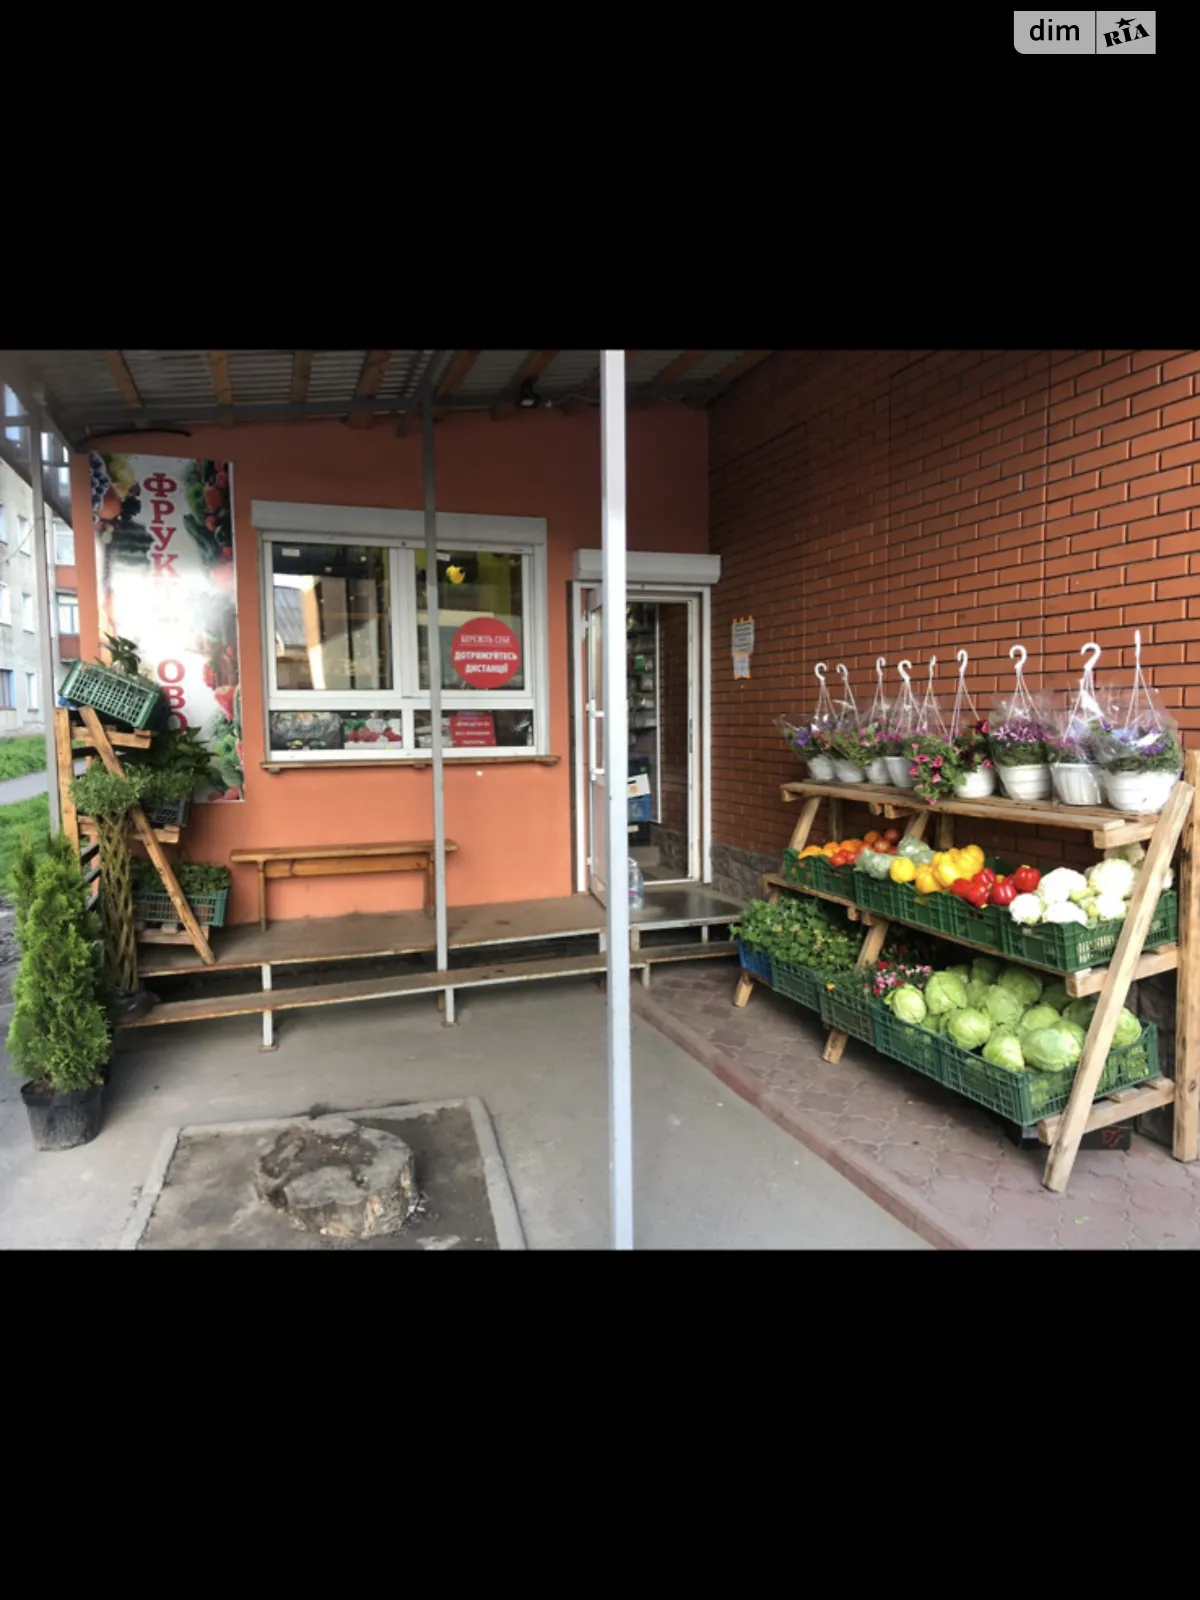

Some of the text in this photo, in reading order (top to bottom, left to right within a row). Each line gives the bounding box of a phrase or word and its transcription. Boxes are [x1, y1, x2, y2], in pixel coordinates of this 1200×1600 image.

[143, 472, 181, 604] ФРУК
[453, 650, 518, 661] ДОТРИМУЙТЕСЬ
[464, 662, 508, 674] ДИСТАНЦІЇ
